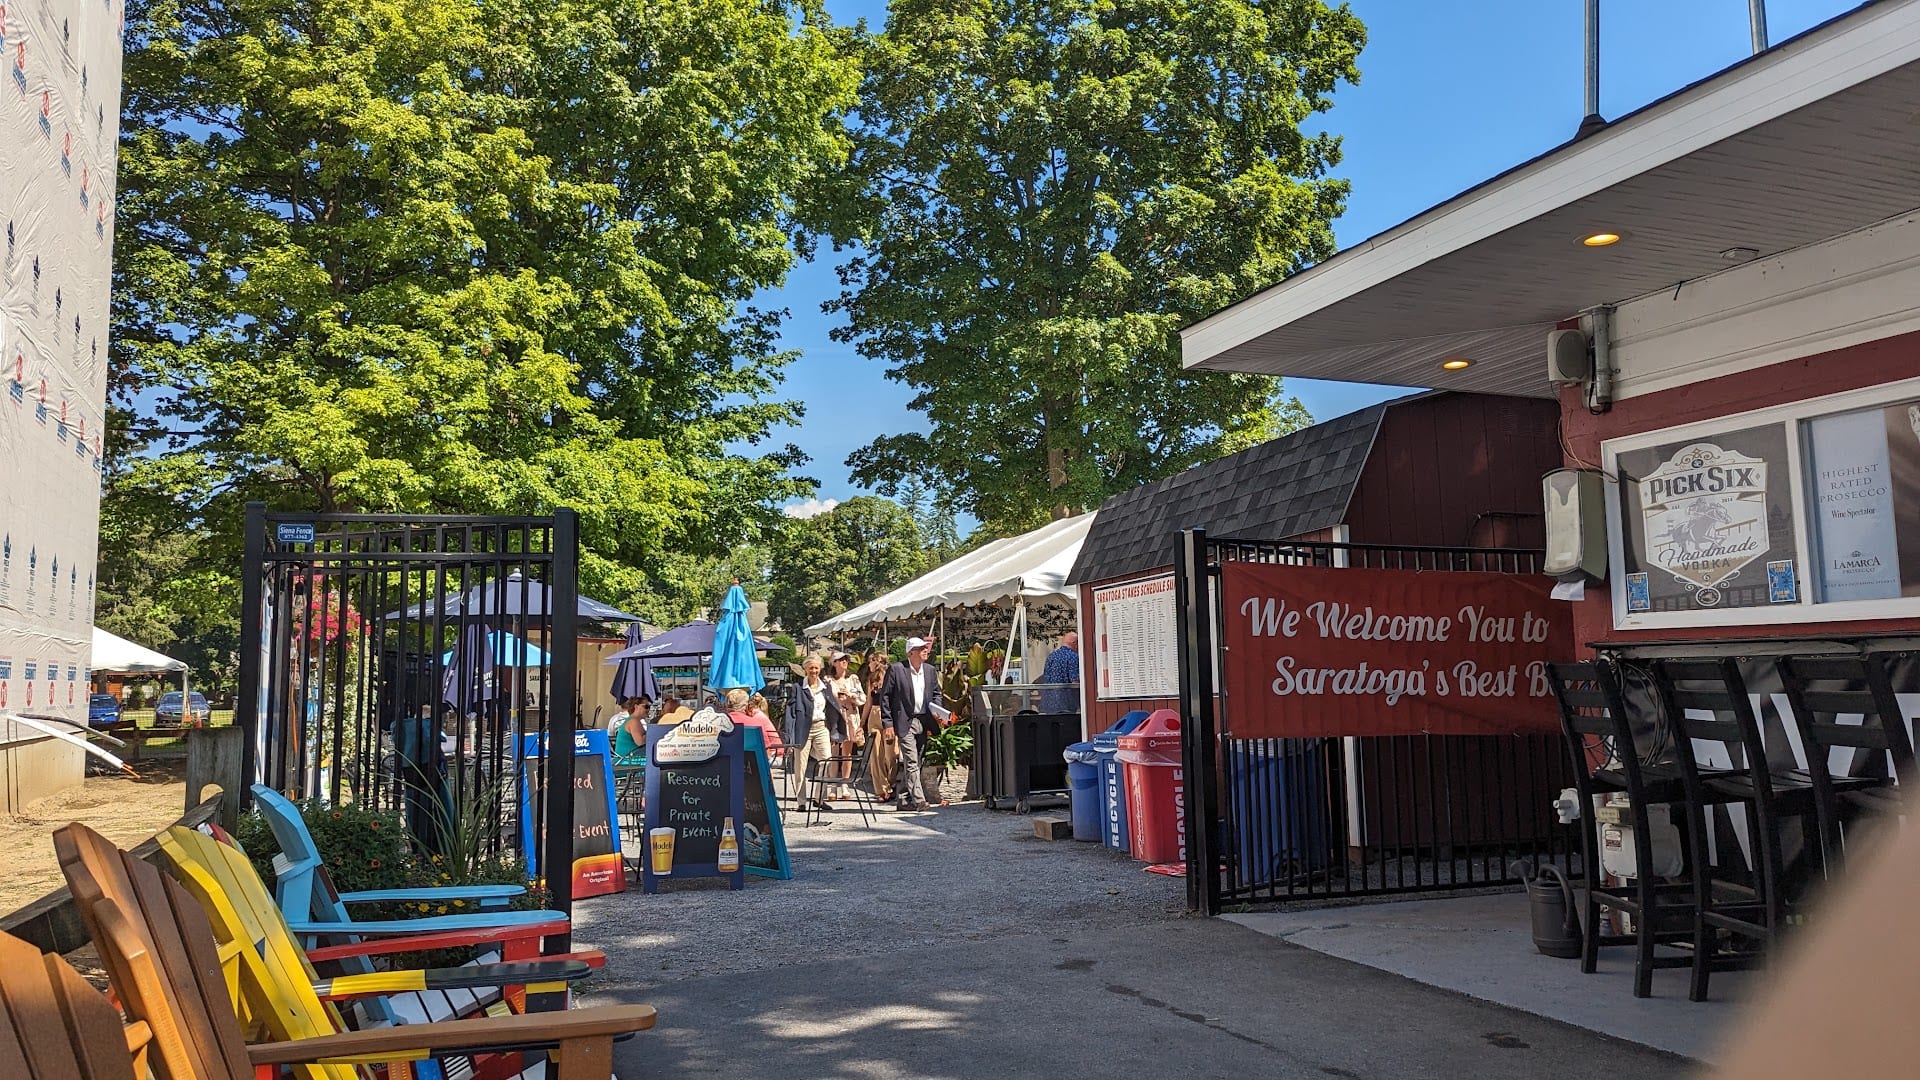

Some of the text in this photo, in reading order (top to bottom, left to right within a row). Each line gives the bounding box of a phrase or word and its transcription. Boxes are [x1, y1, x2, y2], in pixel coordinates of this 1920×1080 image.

[1822, 463, 1879, 479] HIGHEST
[1649, 466, 1757, 504] PICK SIX
[1831, 477, 1872, 490] RATED
[1820, 487, 1886, 503] PROSECCO
[1831, 507, 1876, 519] Wine Spectator
[1658, 536, 1759, 567] Handmade
[1681, 558, 1731, 571] VODKA
[1096, 590, 1121, 604] SARATOGA
[1122, 585, 1140, 600] STAKES
[1140, 582, 1166, 596] SCHEDULE
[1240, 597, 1550, 643] We Welcome You to
[1271, 655, 1450, 706] Saratoga's
[1452, 659, 1518, 698] Best
[682, 723, 713, 734] Modelo
[667, 771, 721, 788] Reserved
[682, 790, 701, 806] for
[1108, 762, 1120, 848] RECYCLE
[669, 808, 712, 822] Private
[579, 820, 609, 839] Event
[590, 869, 614, 877] American
